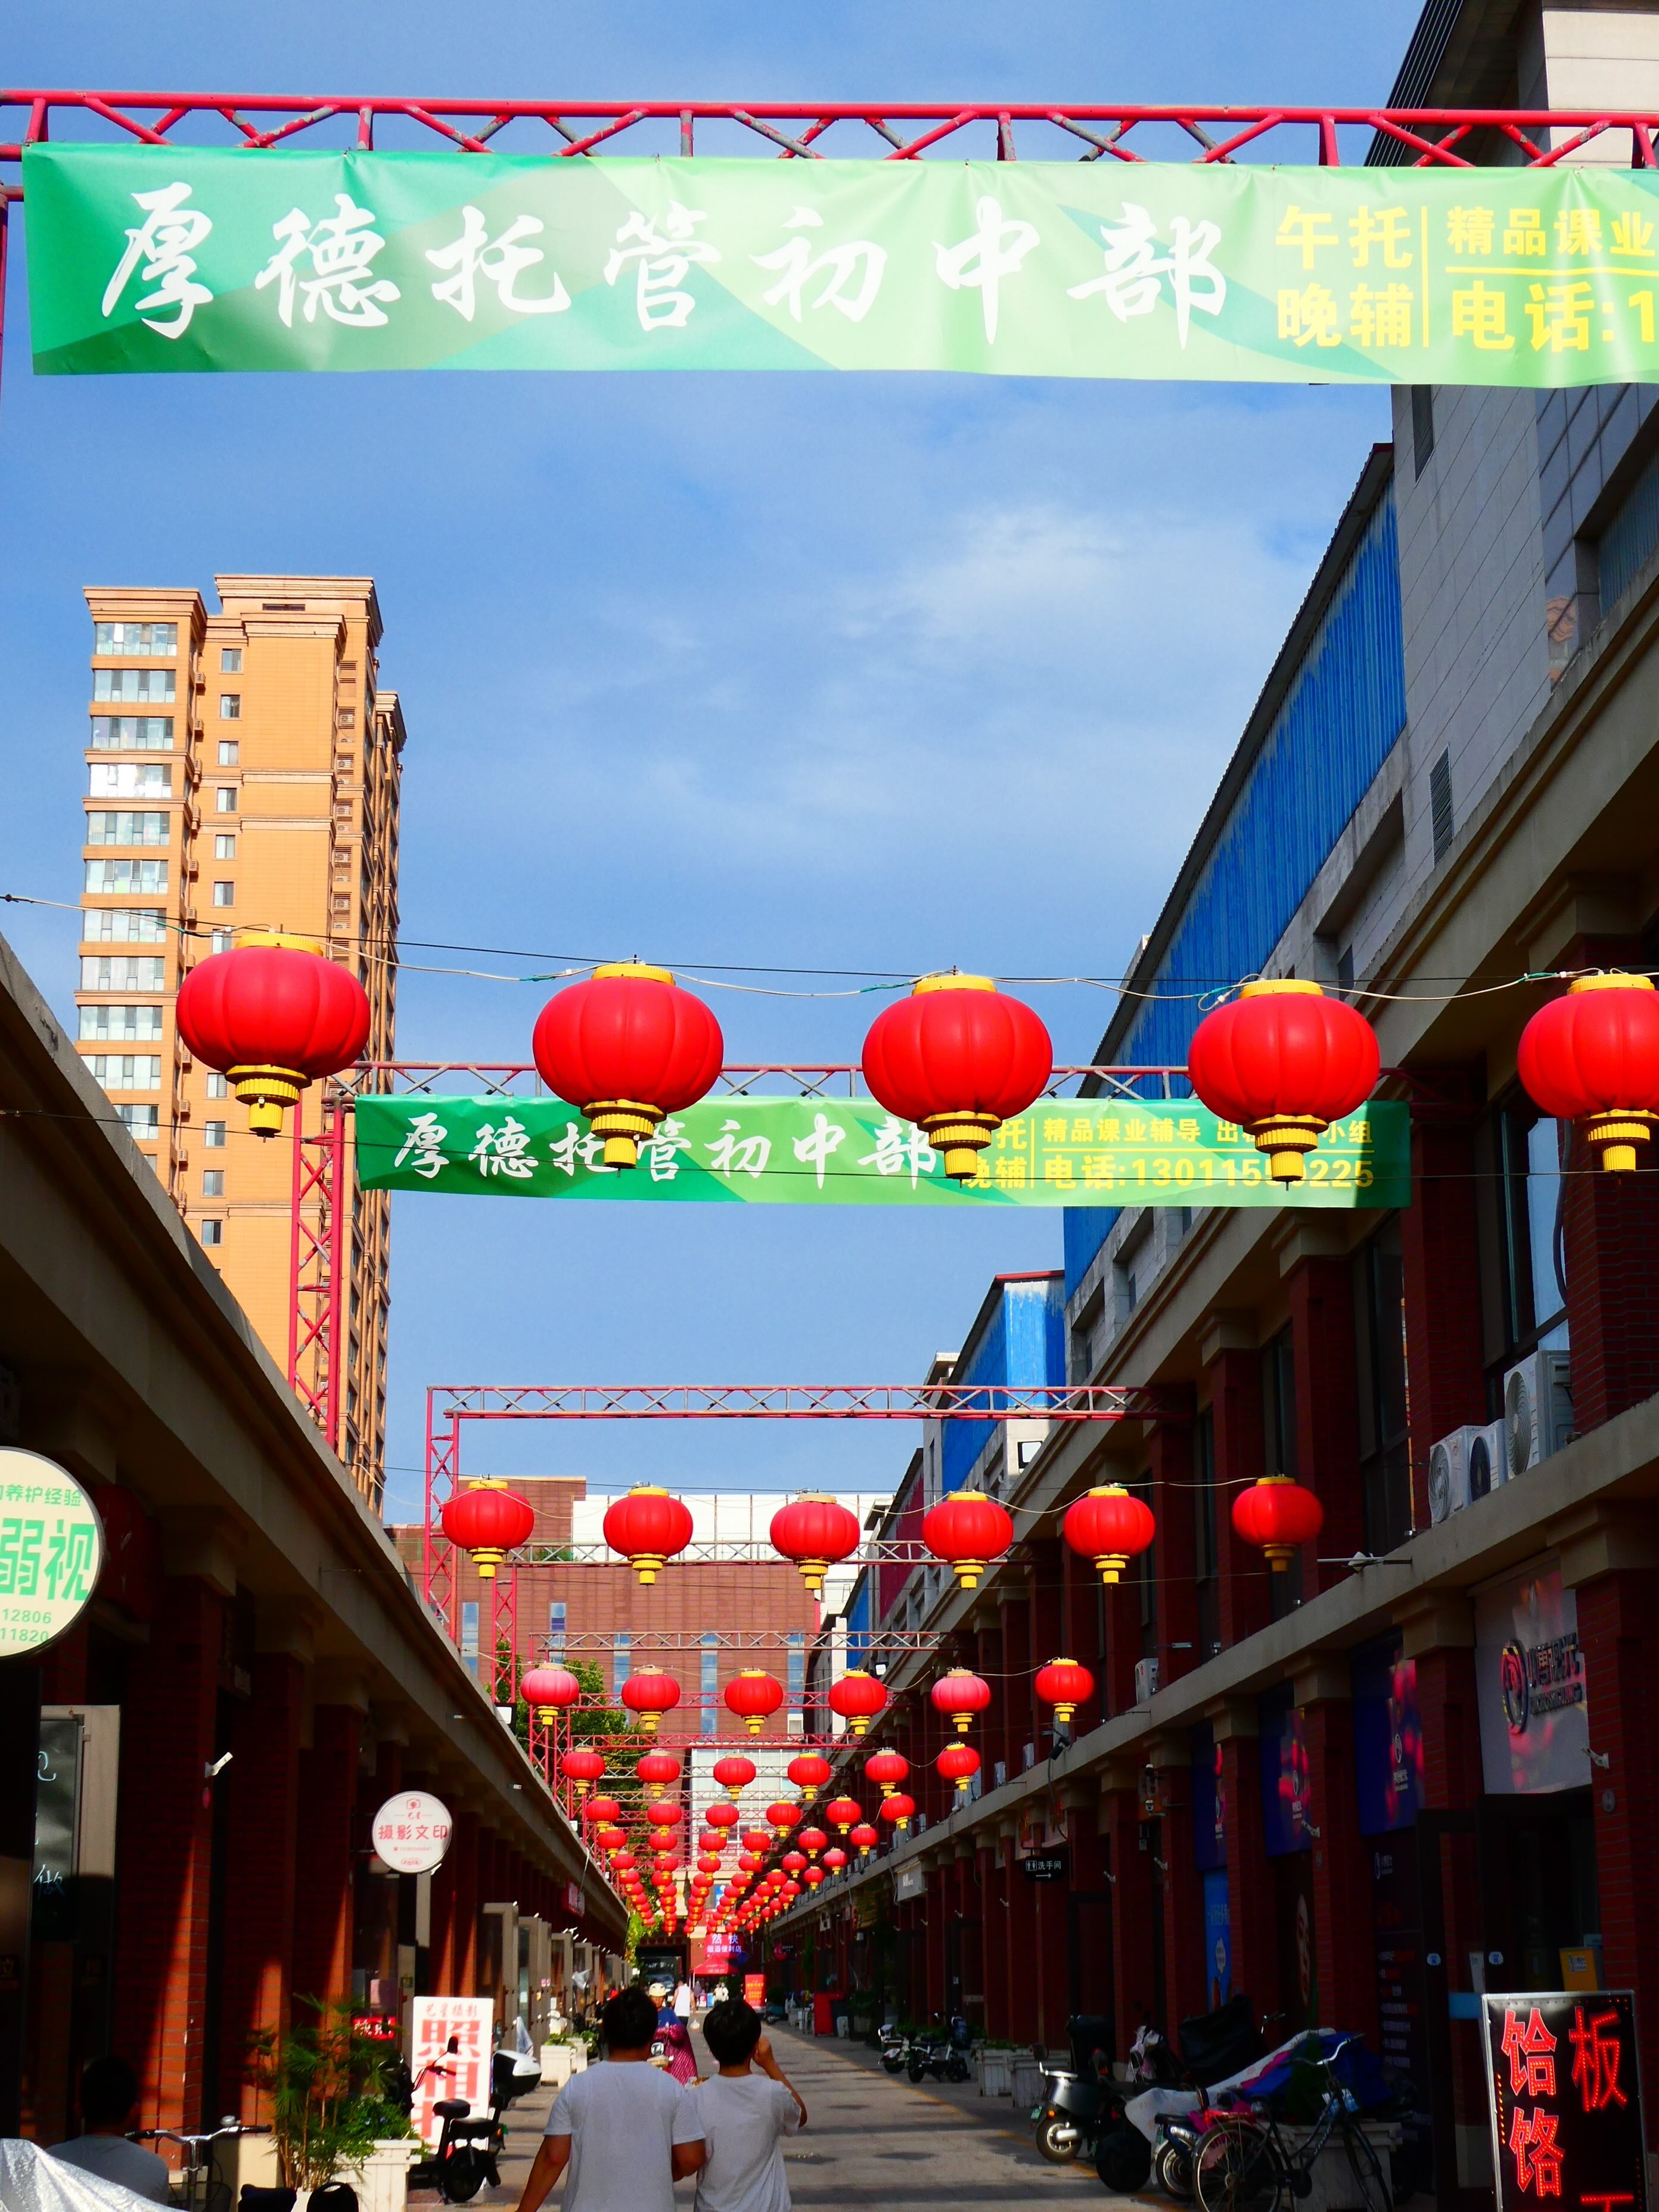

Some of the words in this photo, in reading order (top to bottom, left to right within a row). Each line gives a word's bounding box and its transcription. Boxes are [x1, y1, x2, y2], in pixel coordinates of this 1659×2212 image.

[1276, 205, 1413, 270] 午托
[1446, 206, 1656, 257] 精品课业
[102, 181, 1226, 350] 厚德托管初中部
[1277, 282, 1413, 347] 晚辅
[1452, 280, 1655, 353] 电话:1
[394, 1111, 936, 1191] 厚德托管初中部
[1043, 1118, 1201, 1143] 精品课业辅导
[1044, 1155, 1374, 1189] 电话:130115225
[0, 1484, 82, 1506] 养护经验
[0, 1517, 97, 1601] 弱视
[378, 1825, 448, 1840] 摄影文印
[1037, 1860, 1061, 1870] 洗手间
[1501, 2007, 1565, 2199] 饸饹
